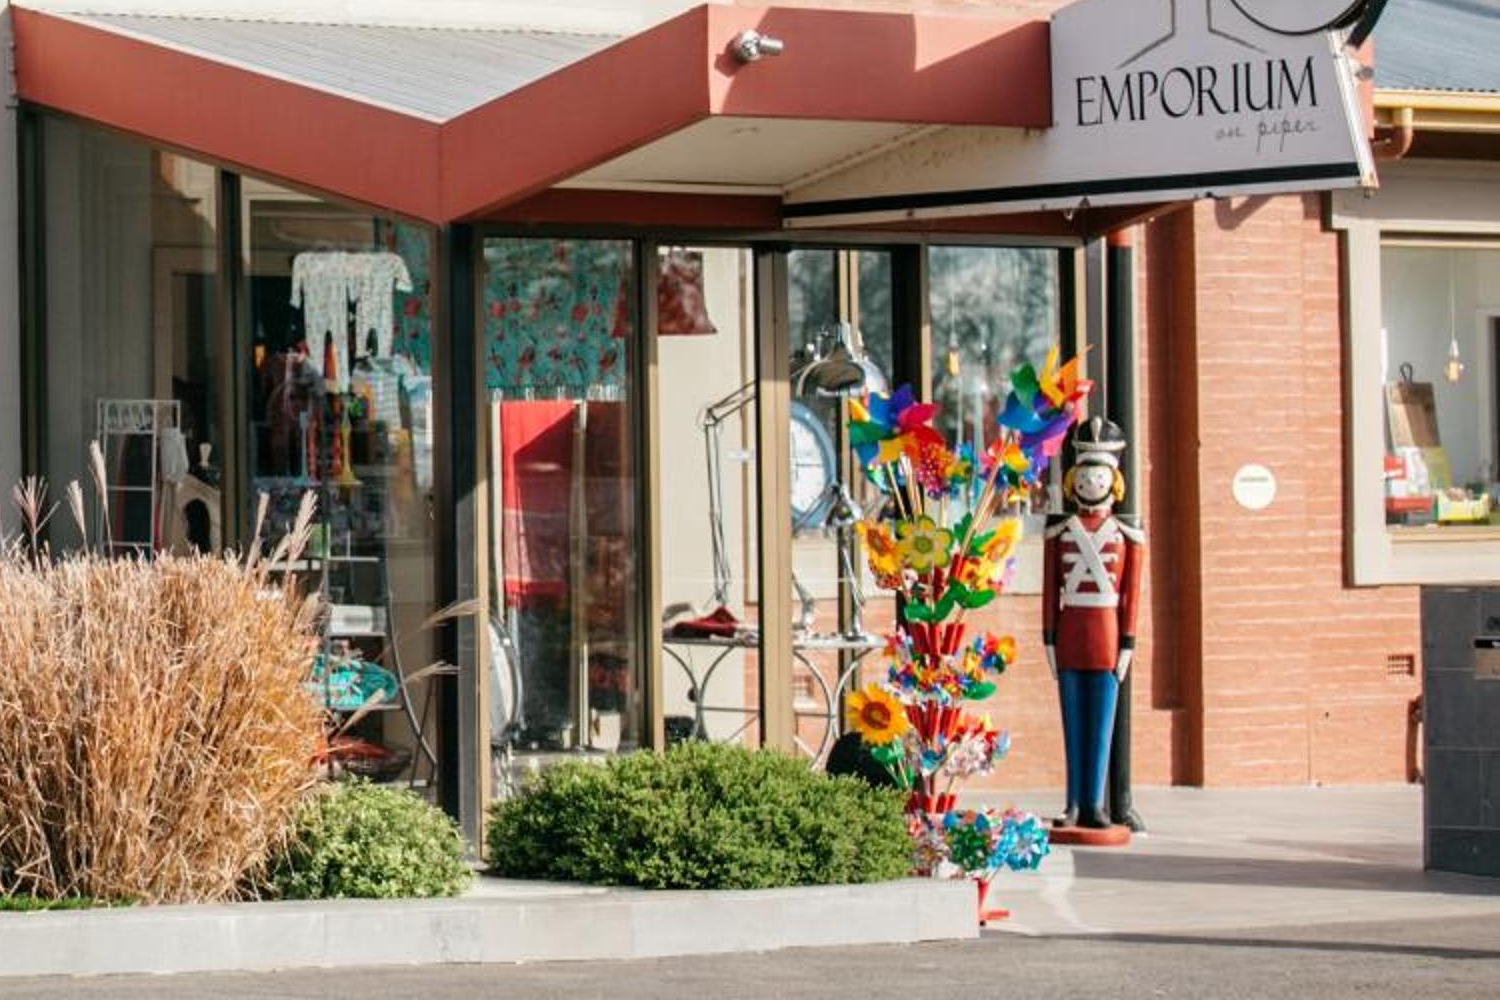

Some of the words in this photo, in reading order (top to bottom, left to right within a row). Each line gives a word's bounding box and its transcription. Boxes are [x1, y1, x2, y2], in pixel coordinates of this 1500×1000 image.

[1076, 56, 1317, 126] EMPORIUM
[1215, 126, 1245, 141] on
[1255, 119, 1319, 153] piper
